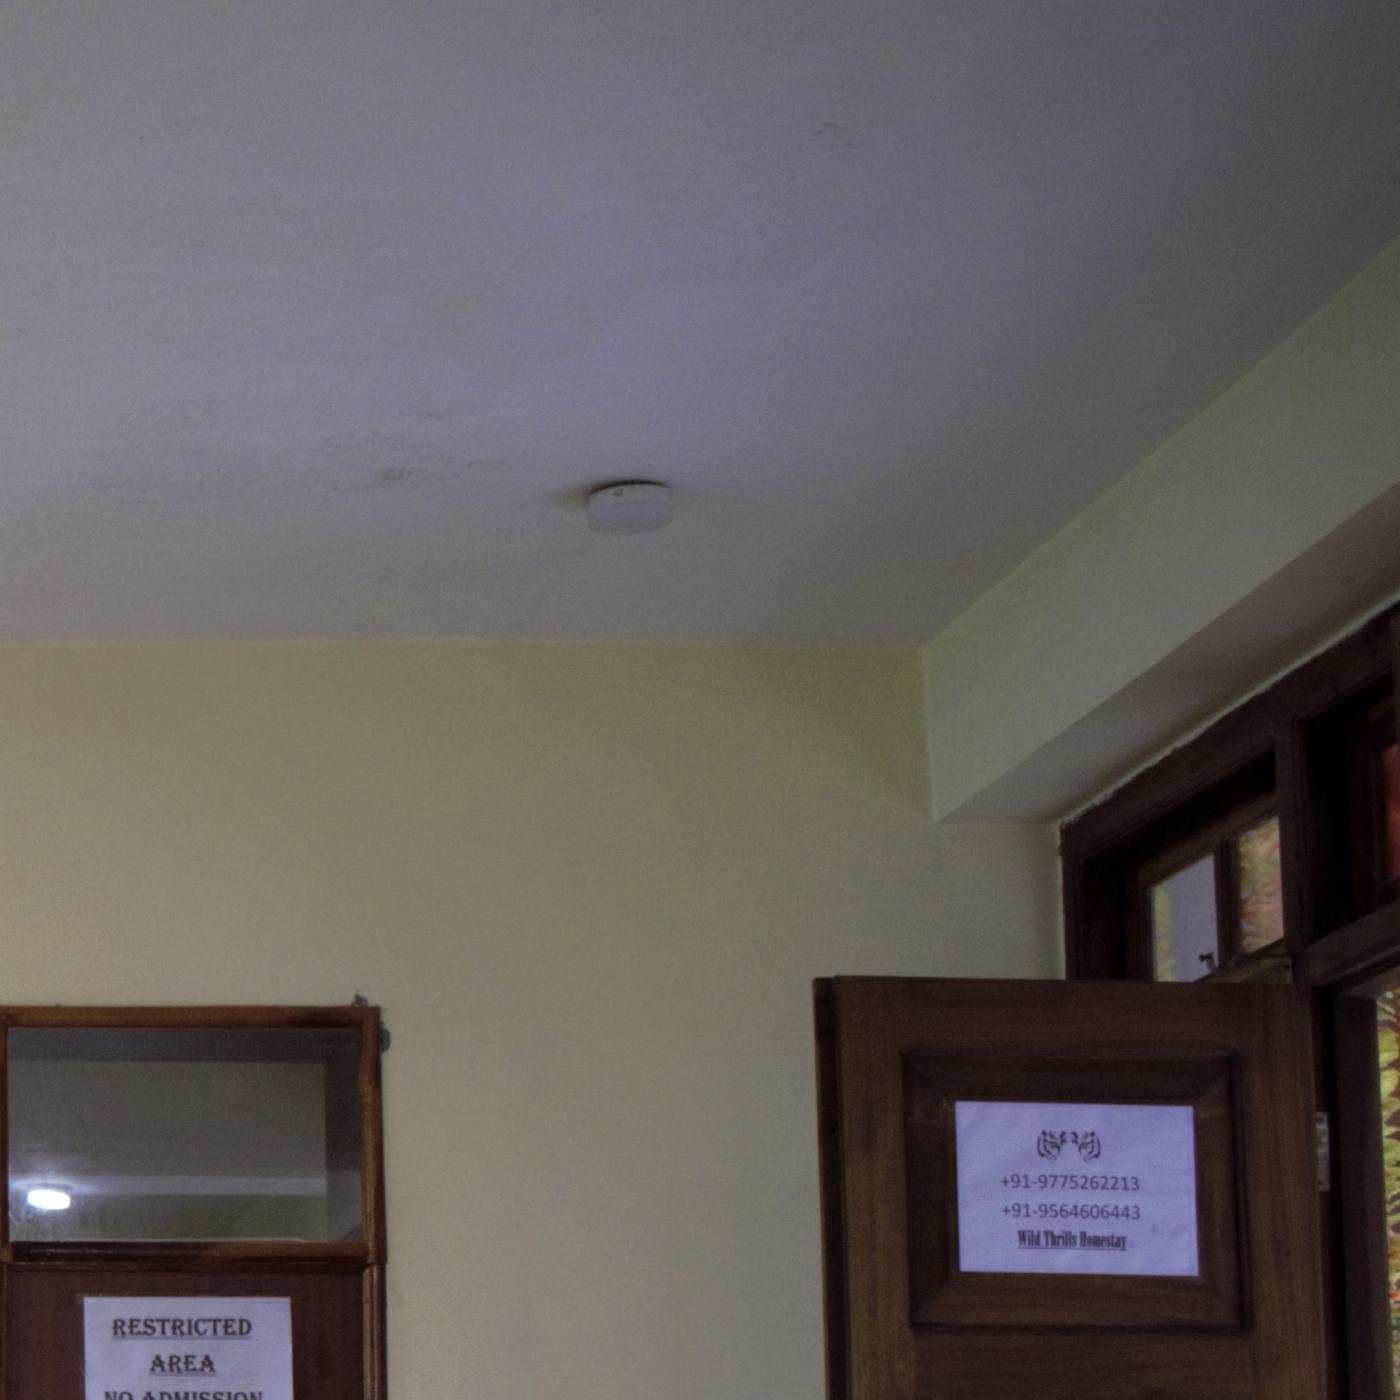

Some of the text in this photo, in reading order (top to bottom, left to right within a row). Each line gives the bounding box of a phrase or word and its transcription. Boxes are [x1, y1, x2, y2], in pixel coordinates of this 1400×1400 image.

[1000, 1174, 1140, 1191] +91-9775262213
[1001, 1203, 1141, 1220] +91-9564606443
[1017, 1230, 1127, 1250] Wild Thrills Homestay
[112, 1318, 252, 1338] RESTRICTED
[149, 1354, 216, 1373] AREA
